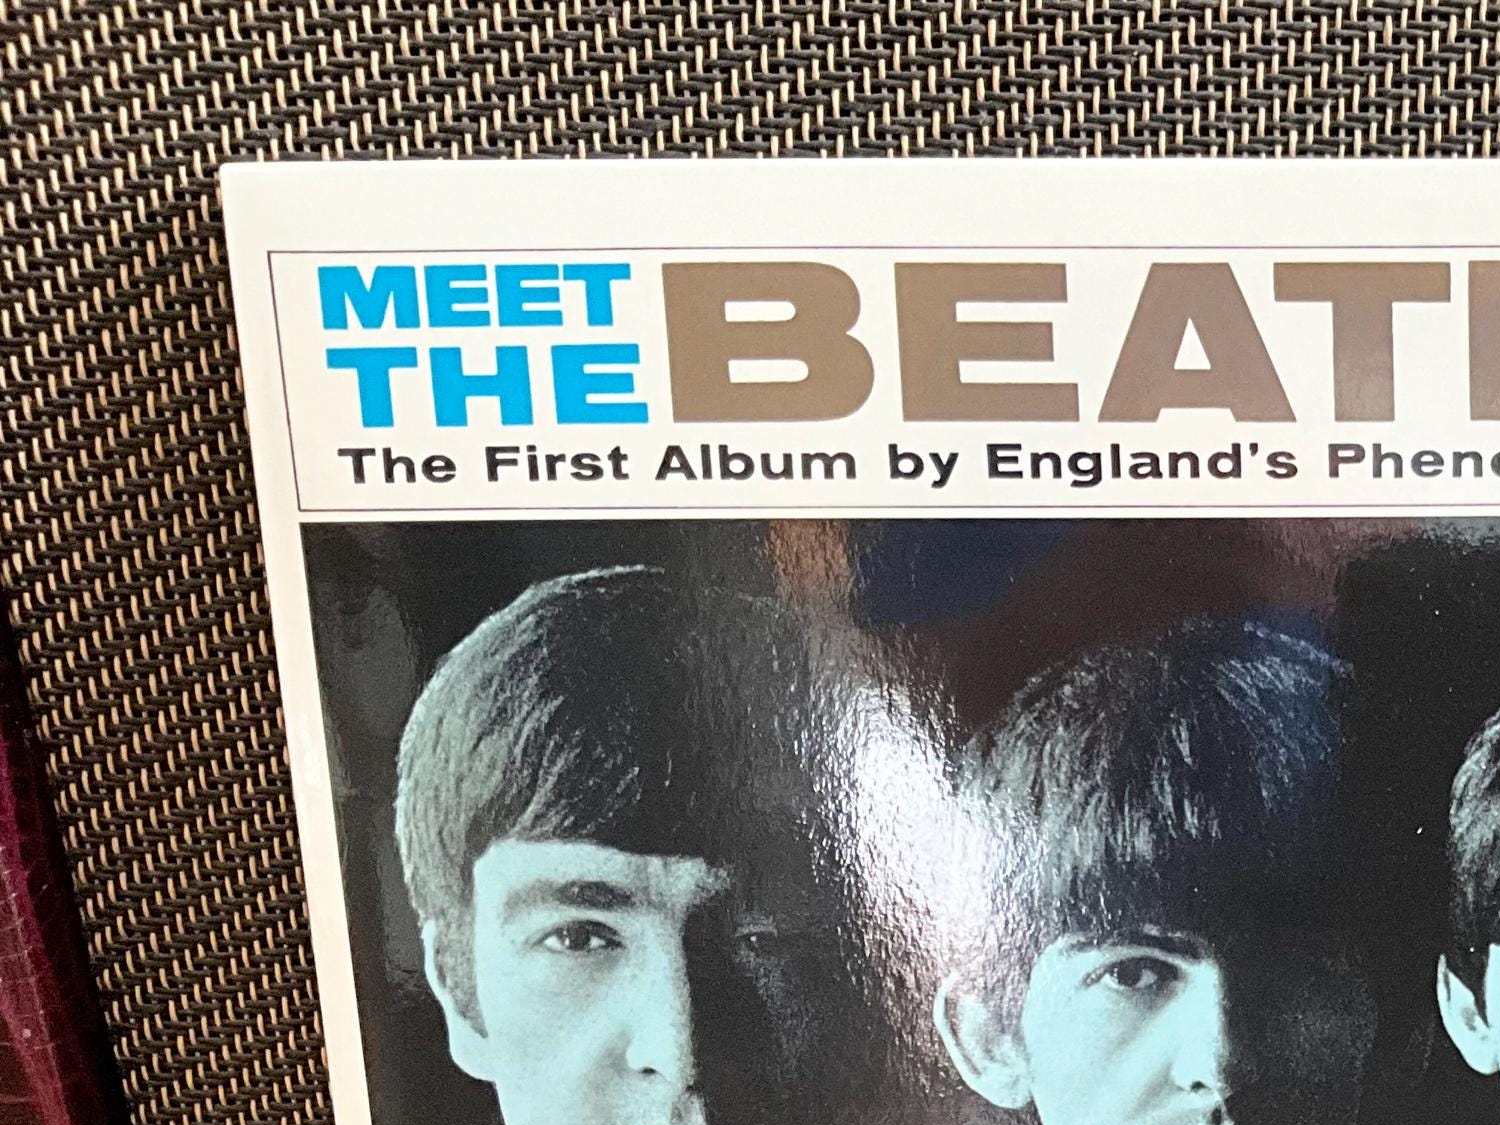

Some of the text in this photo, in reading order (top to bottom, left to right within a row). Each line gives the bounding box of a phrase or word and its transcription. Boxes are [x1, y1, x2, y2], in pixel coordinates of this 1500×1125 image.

[317, 263, 631, 330] MEET
[326, 344, 649, 427] THE
[337, 446, 457, 485] The
[485, 444, 630, 482] First
[654, 443, 857, 481] Album
[888, 442, 959, 490] by
[986, 442, 1298, 488] England's
